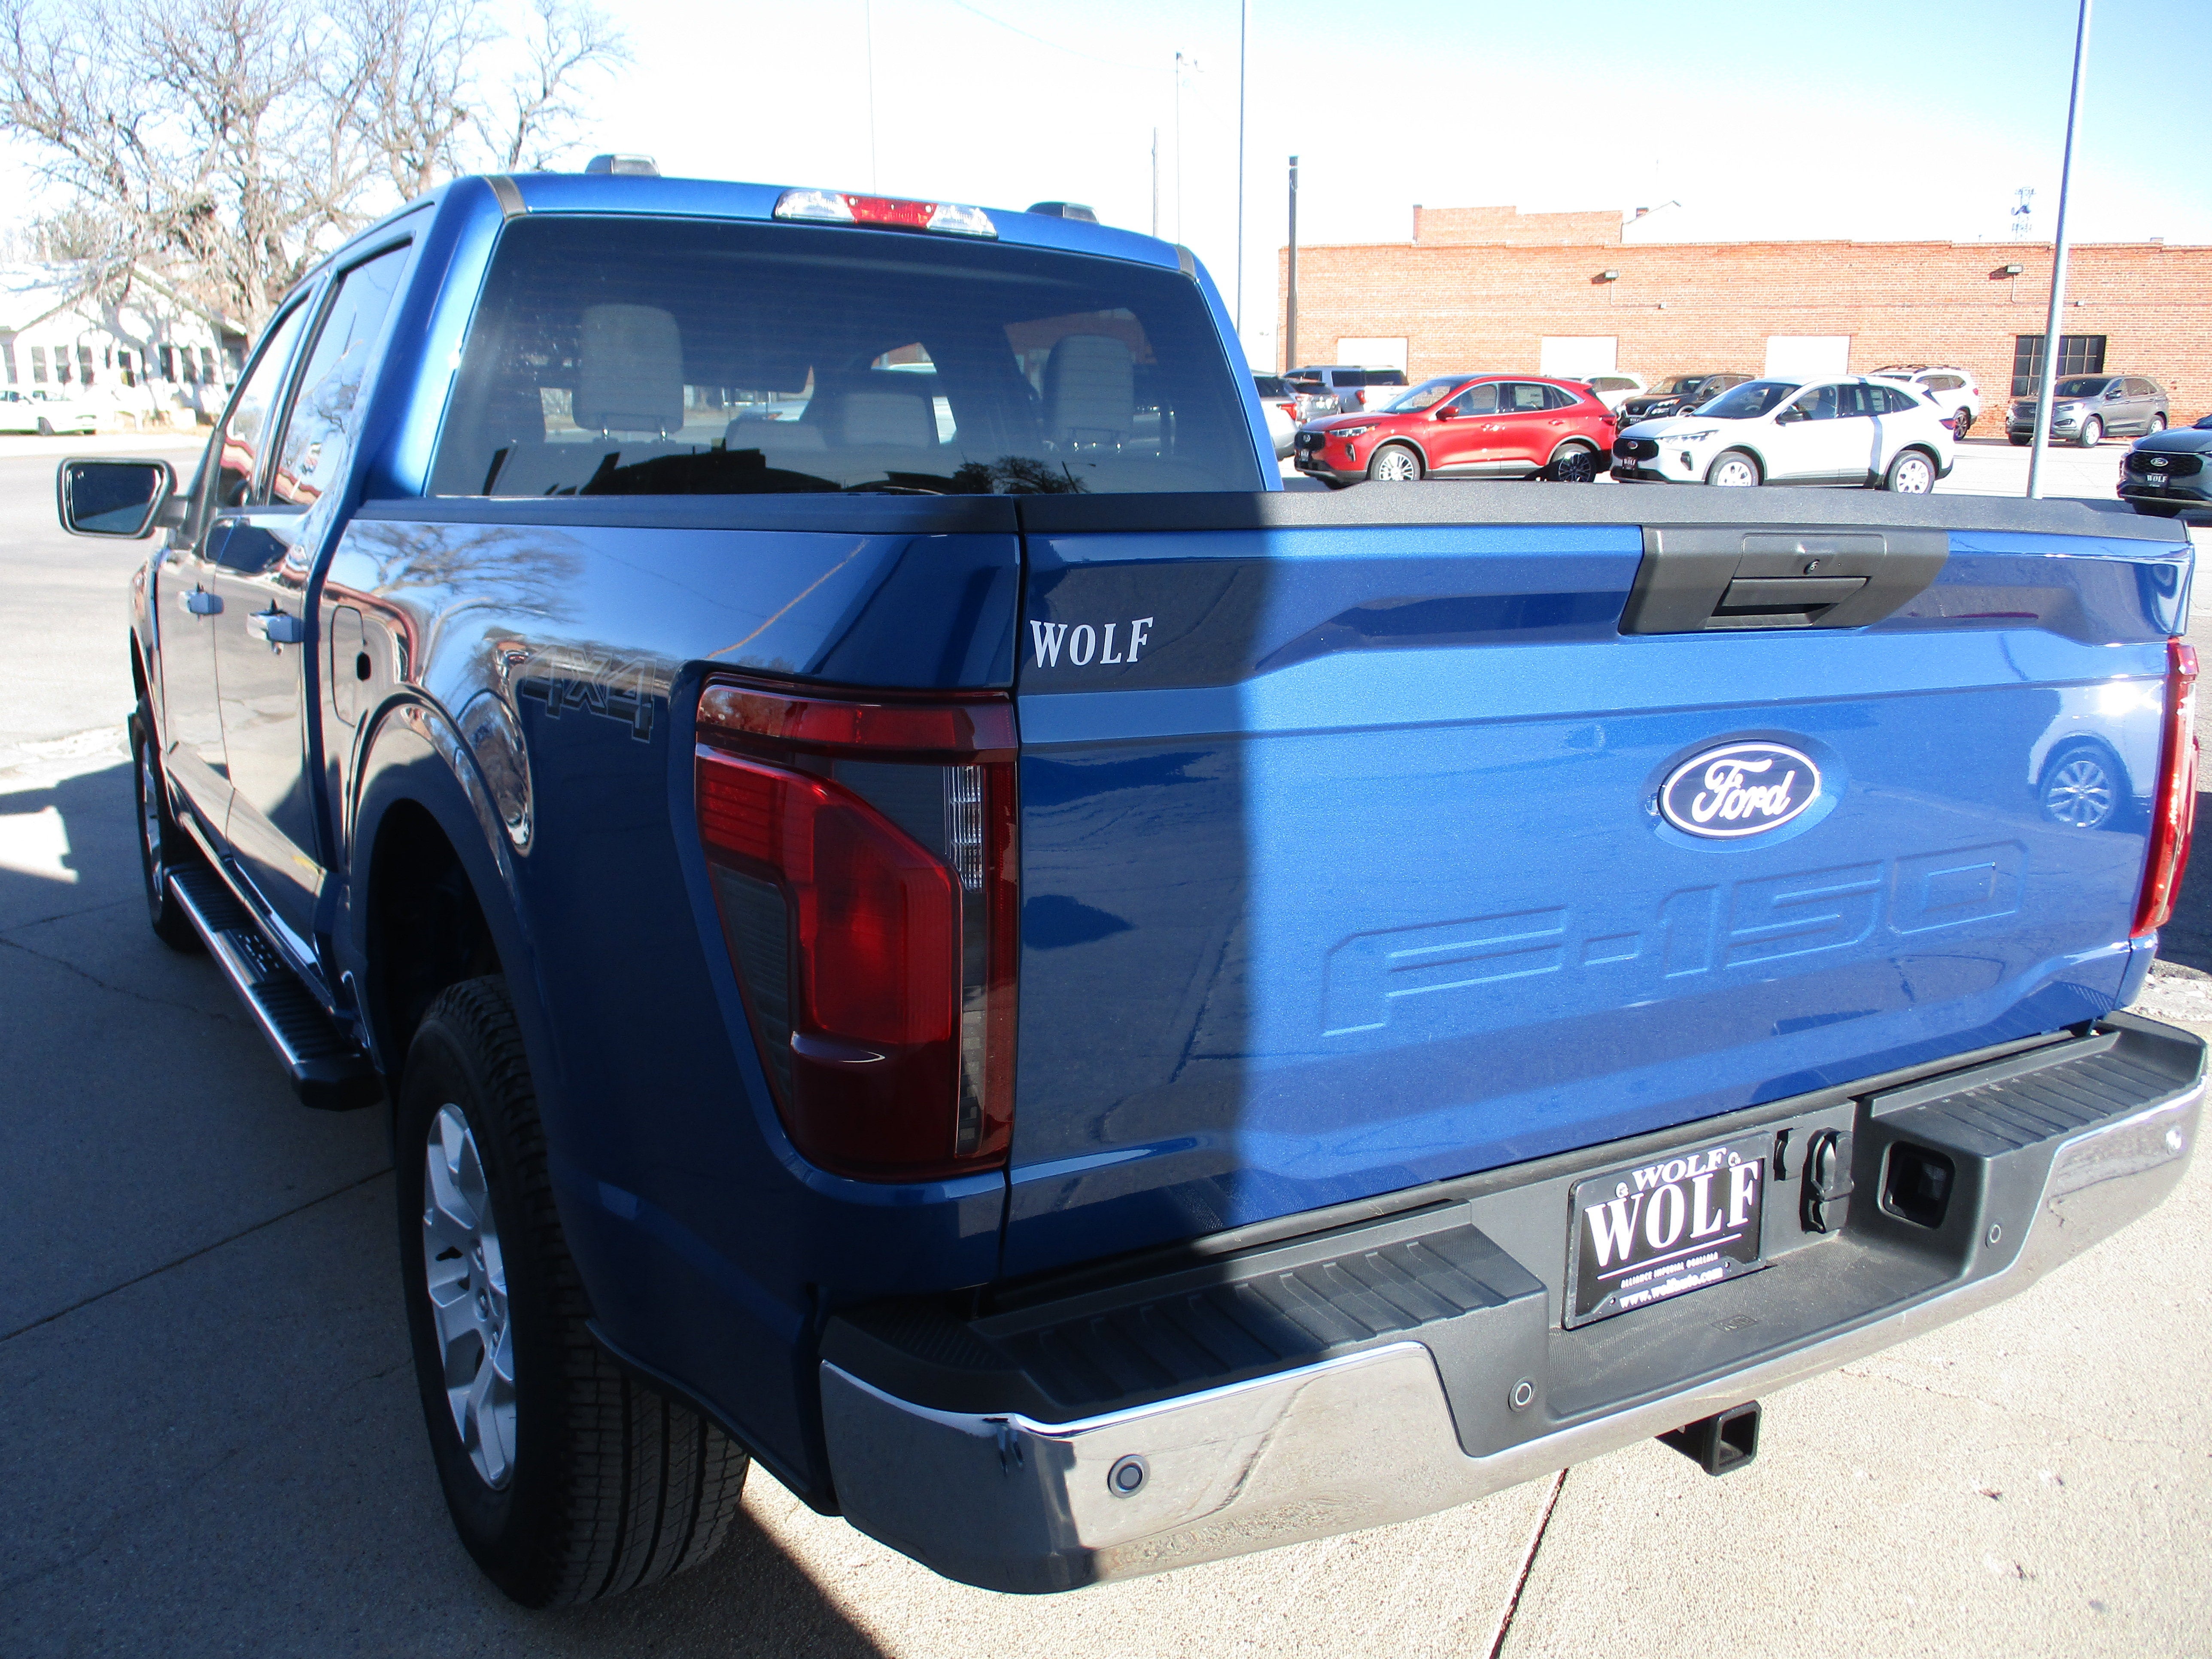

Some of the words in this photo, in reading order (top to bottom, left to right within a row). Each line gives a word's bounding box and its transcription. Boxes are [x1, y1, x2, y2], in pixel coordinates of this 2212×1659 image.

[1030, 617, 1154, 668] WOLF
[1691, 759, 1796, 823] Ford
[1321, 839, 2029, 1038] F-150
[1632, 1147, 1728, 1191] WOLF
[1584, 1161, 1759, 1267] WOLF
[1620, 1270, 1653, 1289] ALLIANCE
[1653, 1261, 1685, 1279] IMPERIAL
